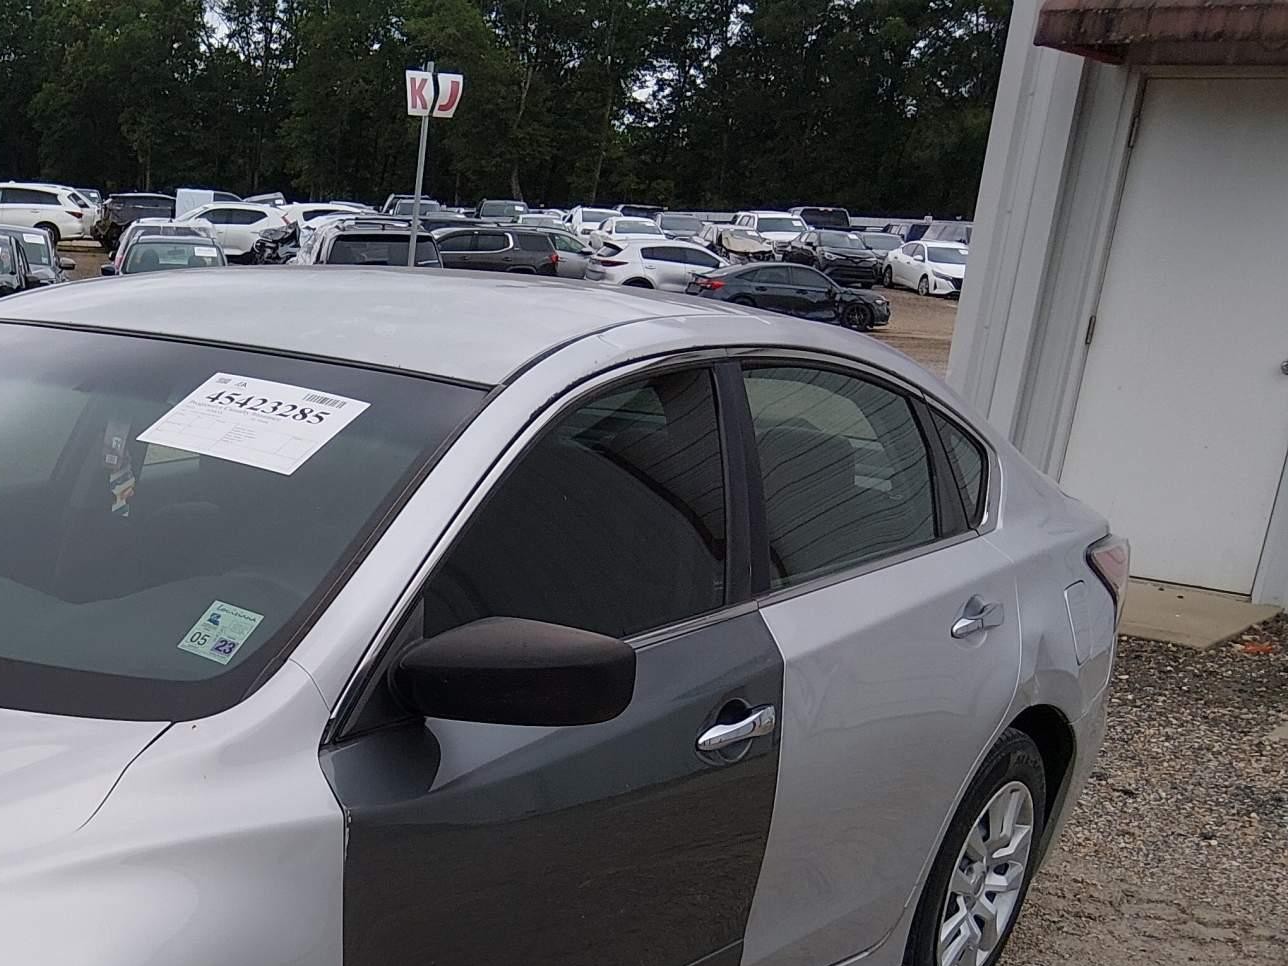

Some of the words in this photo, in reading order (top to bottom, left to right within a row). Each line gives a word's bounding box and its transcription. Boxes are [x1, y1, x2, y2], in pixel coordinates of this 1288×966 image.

[410, 77, 428, 110] K
[437, 80, 461, 111] J
[205, 389, 332, 425] 45423285
[190, 631, 210, 646] 05
[215, 639, 236, 654] 23
